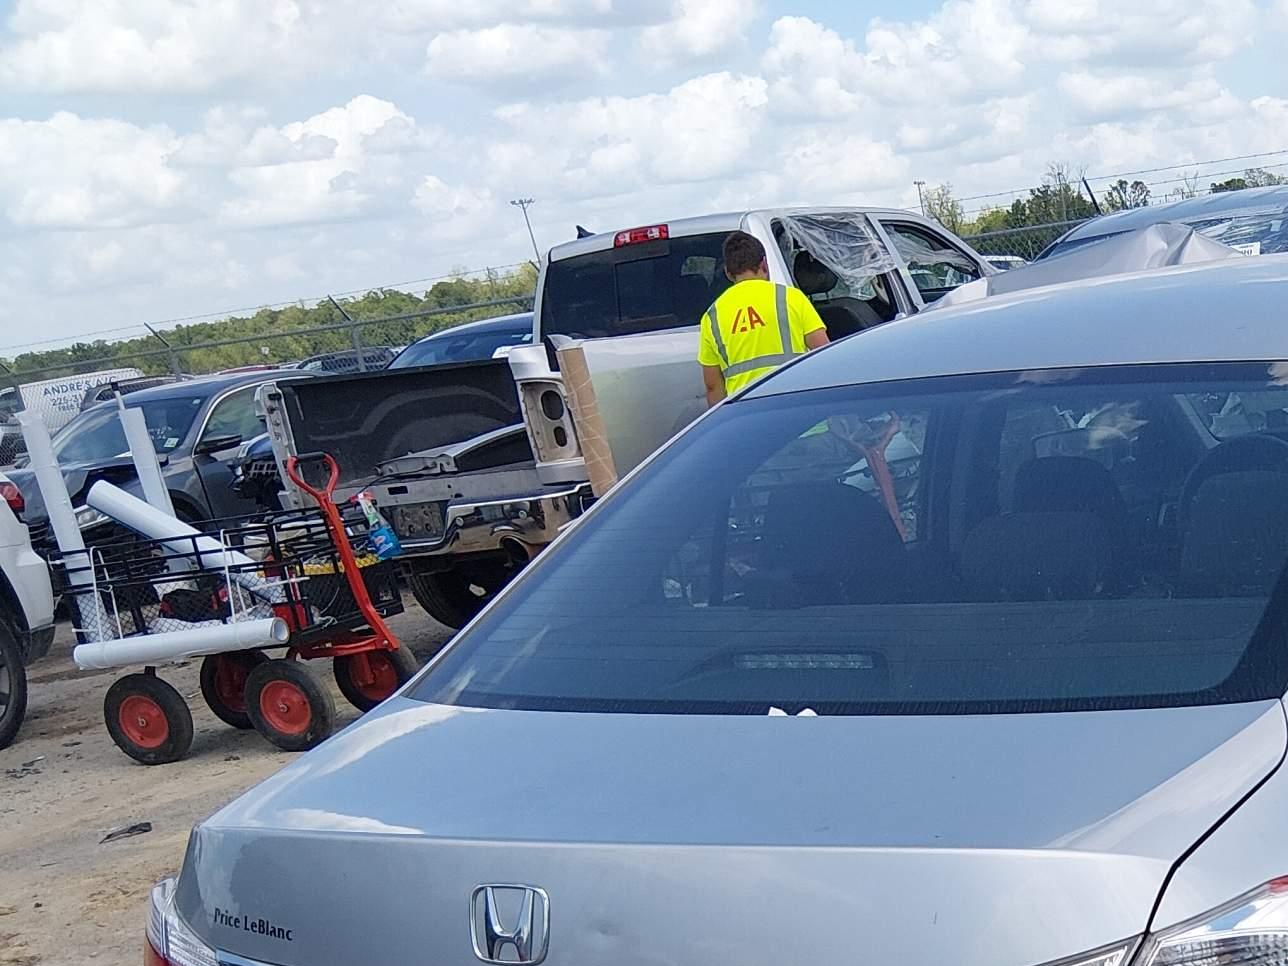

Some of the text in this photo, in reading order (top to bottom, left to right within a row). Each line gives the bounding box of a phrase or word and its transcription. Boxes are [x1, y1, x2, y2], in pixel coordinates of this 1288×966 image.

[43, 380, 92, 396] ANDRE'S
[213, 907, 294, 941] Price LeBlanc
